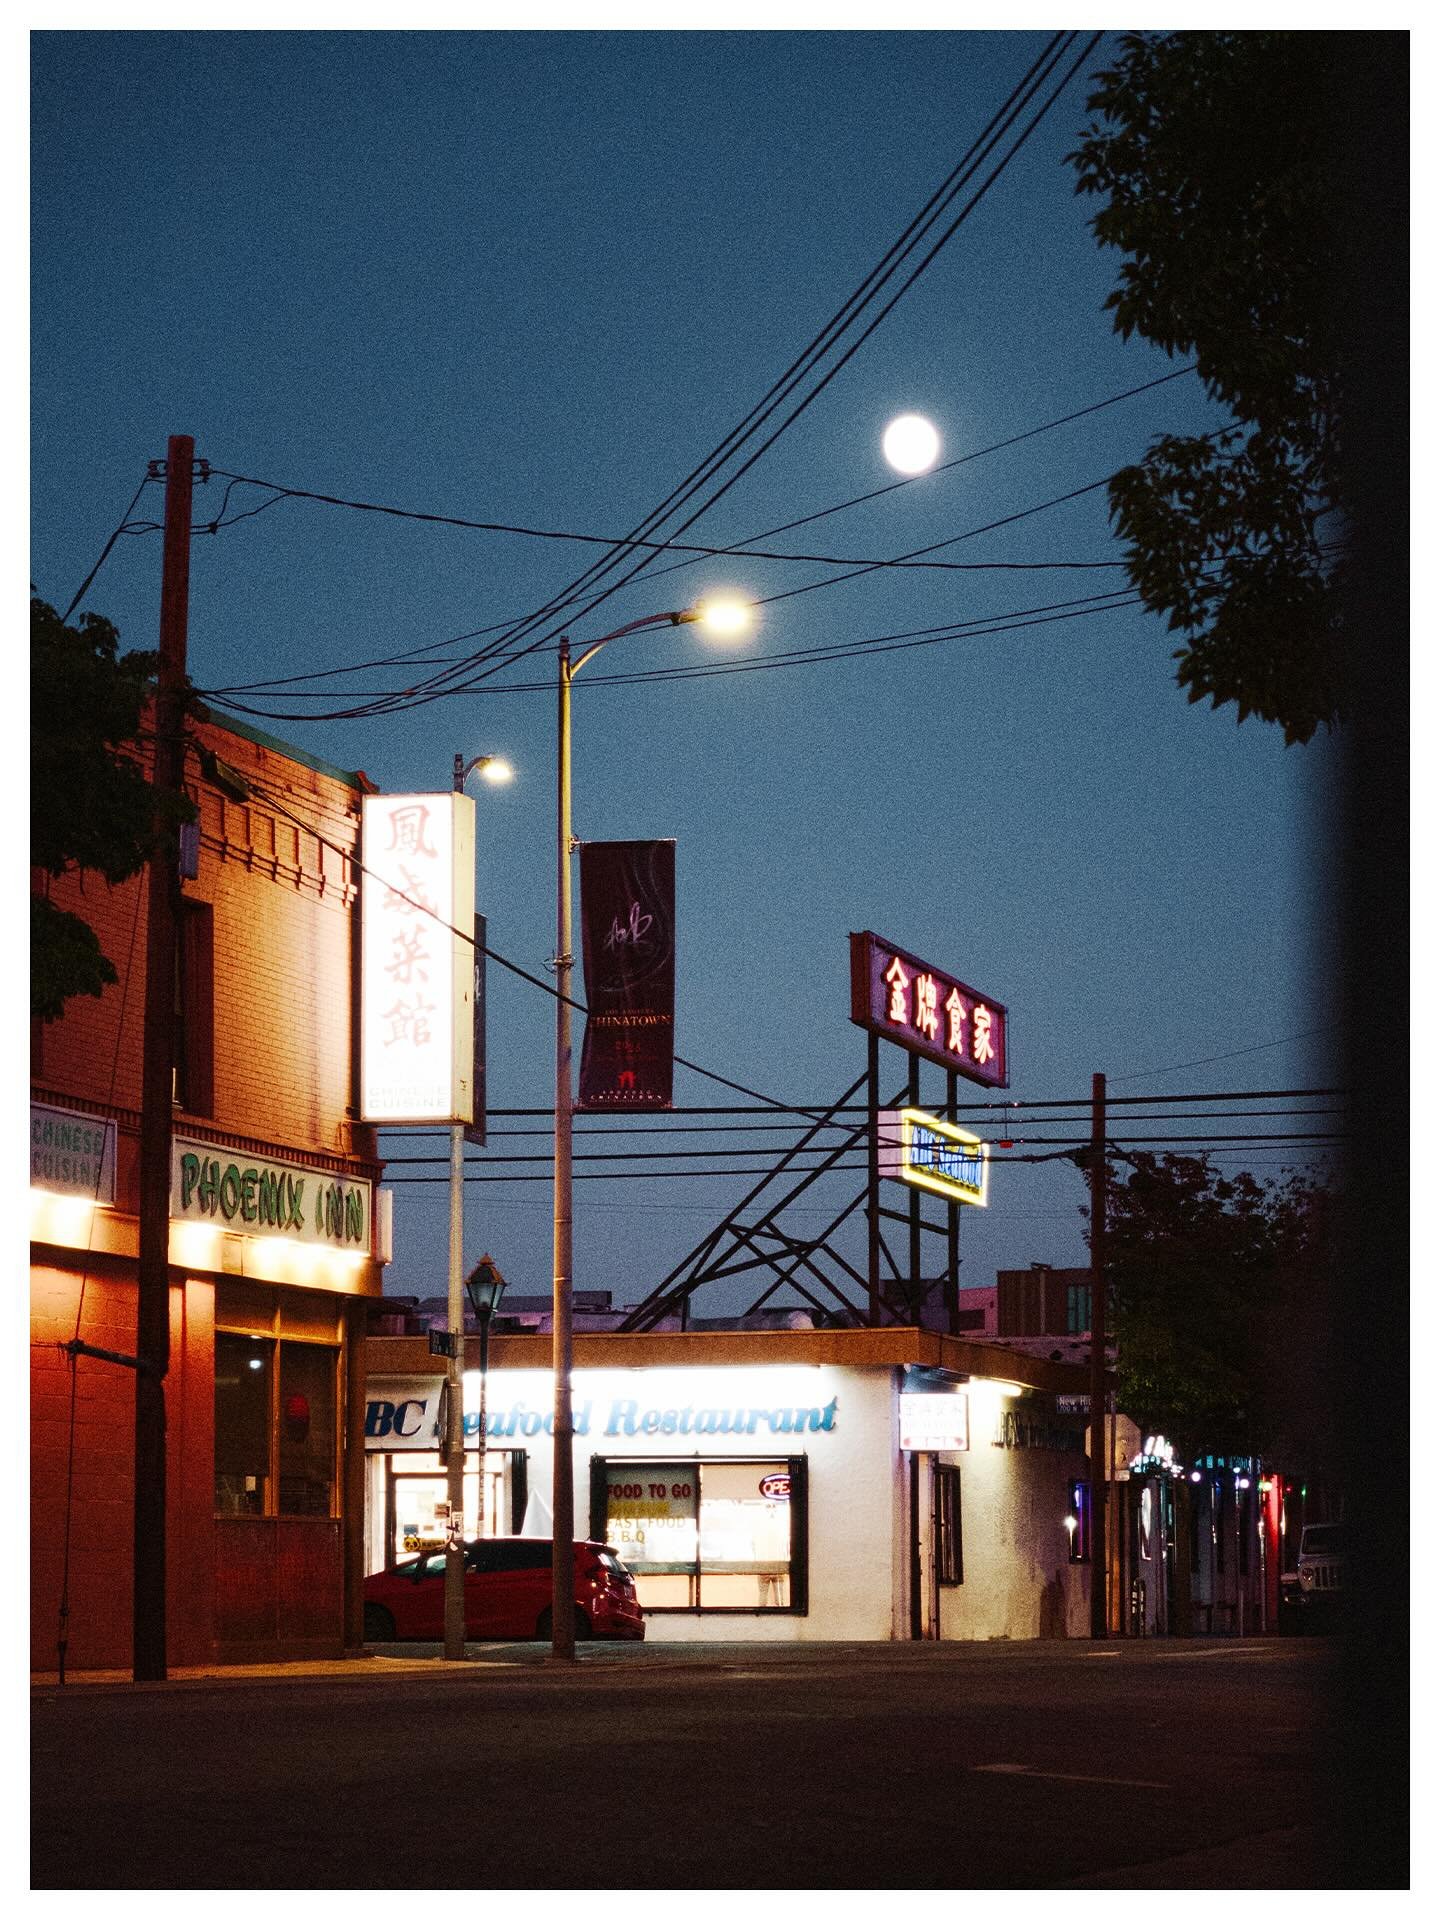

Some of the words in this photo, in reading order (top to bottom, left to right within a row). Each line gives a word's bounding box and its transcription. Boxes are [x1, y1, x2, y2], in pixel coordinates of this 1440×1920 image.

[887, 955, 995, 1065] 金牌食家
[32, 1118, 104, 1156] CHINESE
[181, 1152, 305, 1232] PHOENIX
[315, 1182, 364, 1243] INN
[364, 1399, 428, 1438] BC
[433, 1398, 595, 1438] eafood
[604, 1394, 839, 1438] Restaurant
[608, 1483, 642, 1499] FOOD
[648, 1483, 666, 1498] TO
[671, 1483, 691, 1498] GO
[763, 1480, 791, 1495] OPE
[648, 1516, 686, 1529] FOOD
